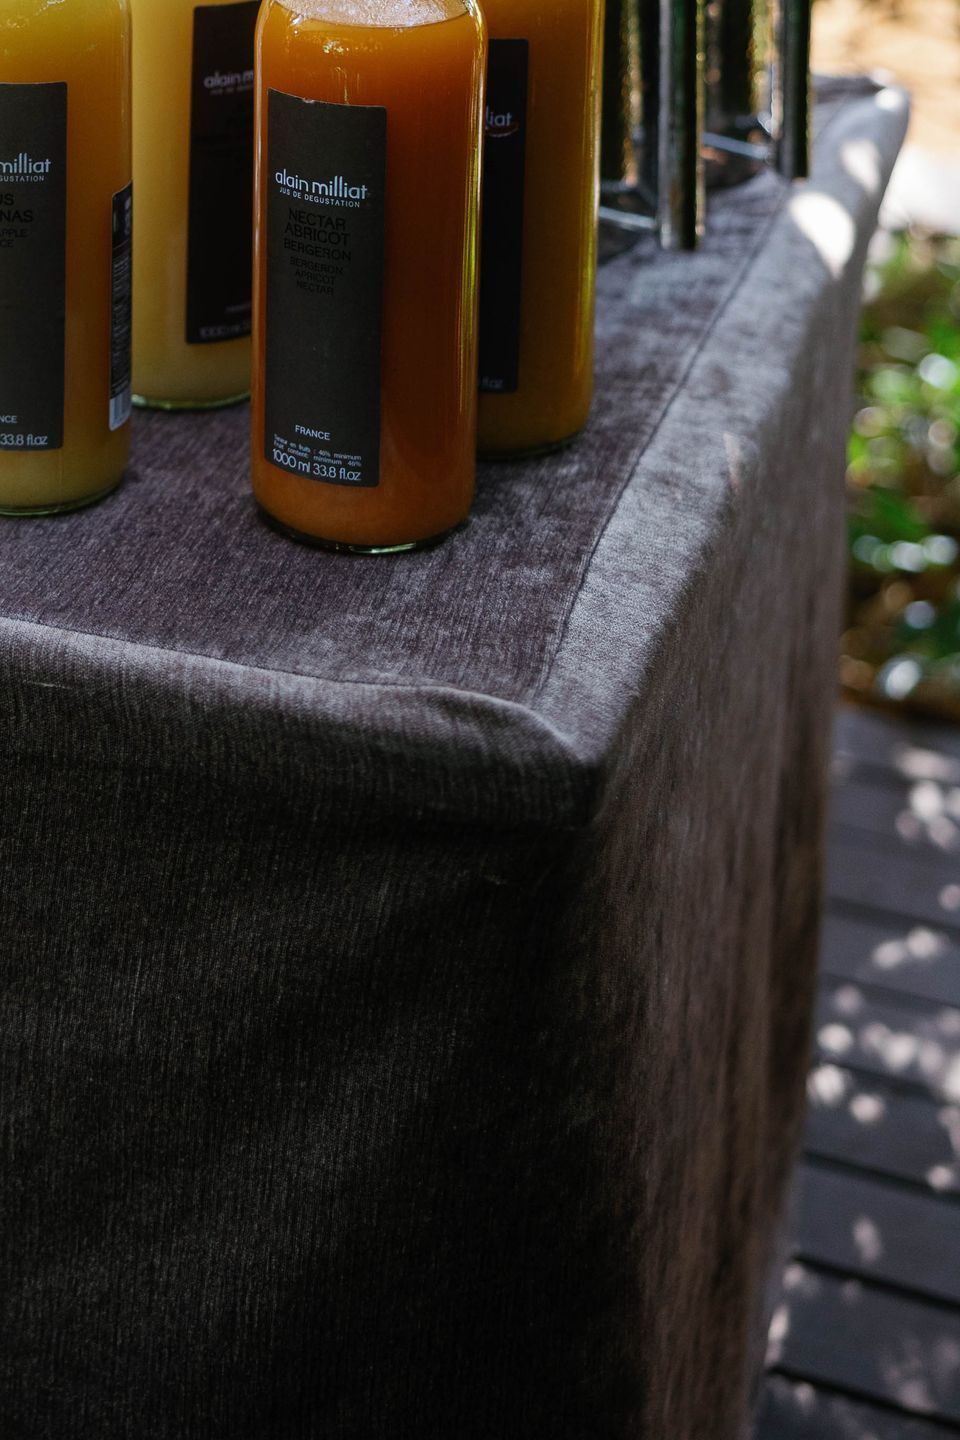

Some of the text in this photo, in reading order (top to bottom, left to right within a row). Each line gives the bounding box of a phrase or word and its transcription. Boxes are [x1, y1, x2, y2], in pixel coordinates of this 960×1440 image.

[275, 168, 368, 200] alain milliat
[304, 193, 360, 208] DEGUSTATION
[288, 207, 346, 231] NECTAR
[284, 221, 351, 247] ABRICOT
[283, 237, 352, 261] BERGERON
[0, 433, 24, 446] 33.8
[295, 424, 331, 441] FRANCE
[272, 448, 297, 468] 1000
[298, 461, 311, 473] ml
[312, 462, 337, 478] 33.8
